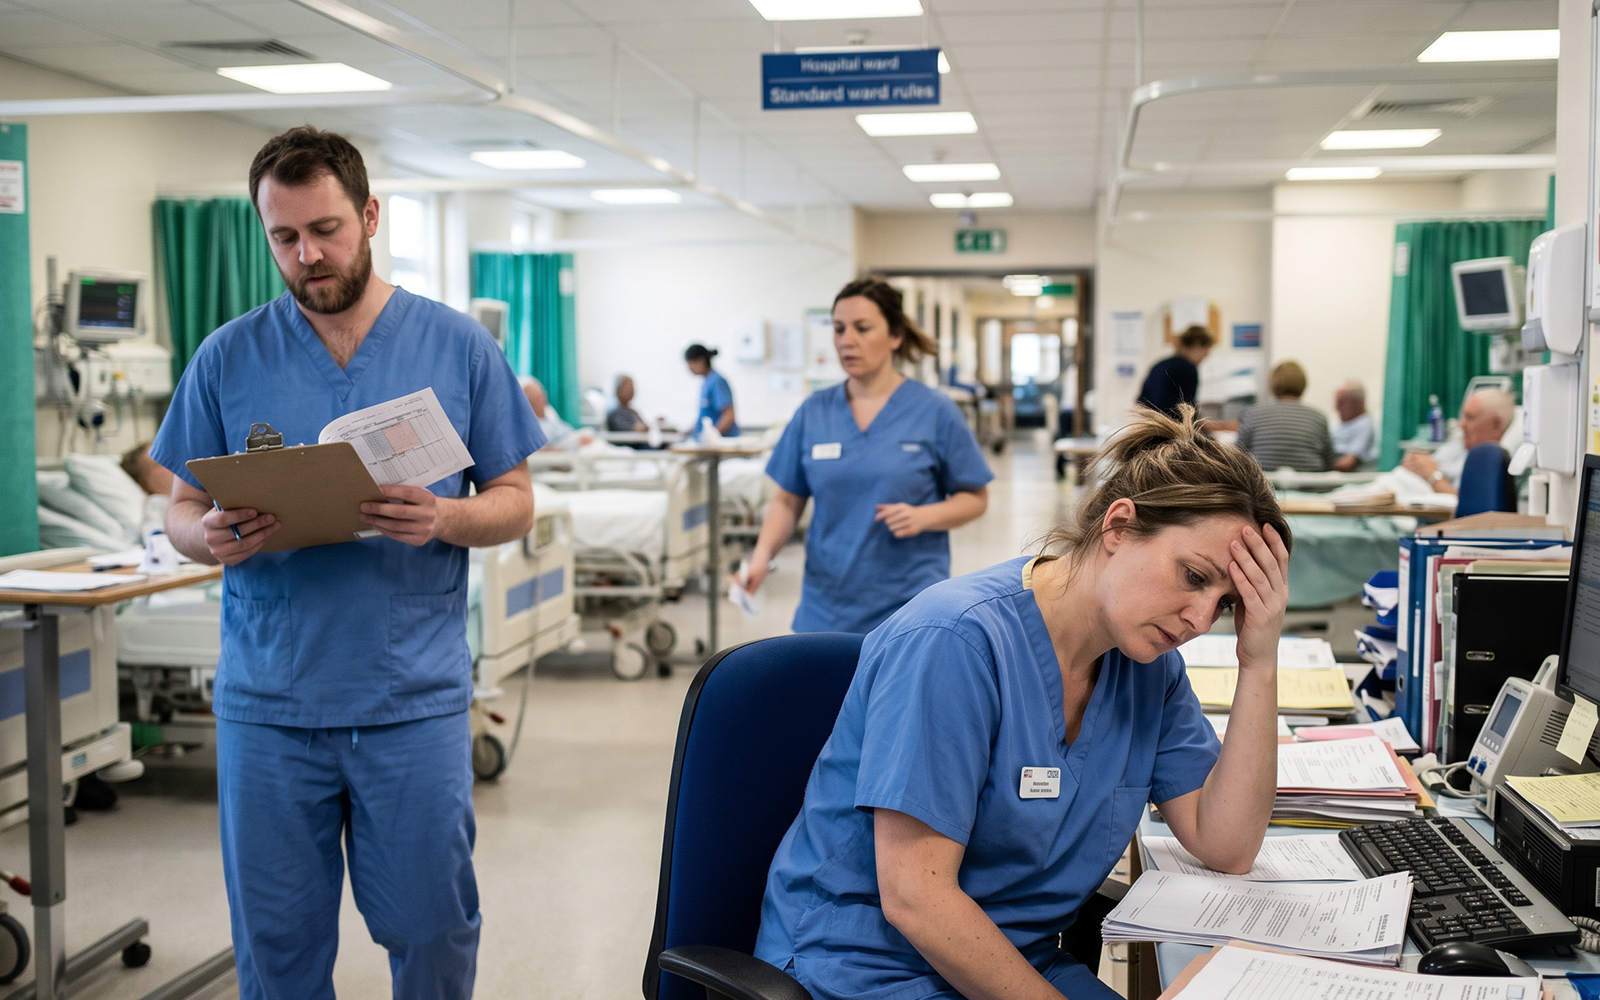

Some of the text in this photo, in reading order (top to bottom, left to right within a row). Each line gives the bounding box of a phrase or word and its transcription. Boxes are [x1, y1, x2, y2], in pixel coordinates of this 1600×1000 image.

[801, 56, 900, 74] Hospital ward
[770, 83, 934, 103] Standard ward rules
